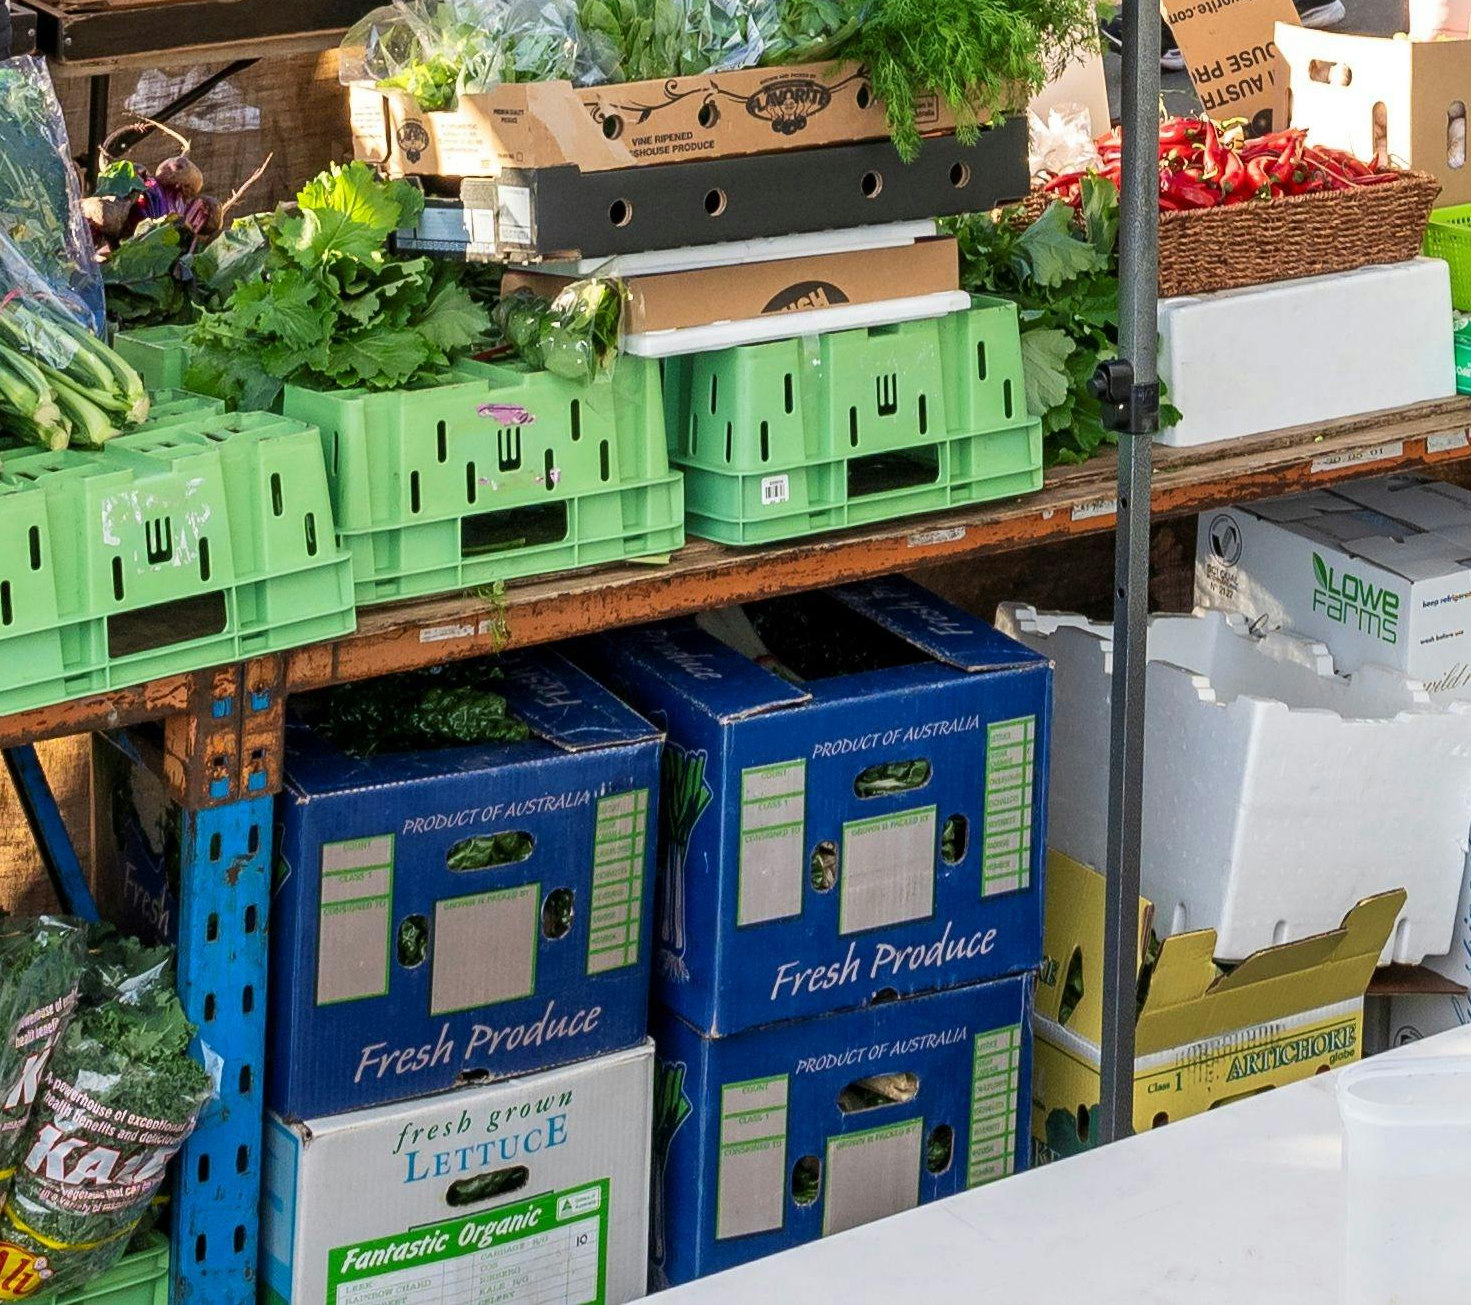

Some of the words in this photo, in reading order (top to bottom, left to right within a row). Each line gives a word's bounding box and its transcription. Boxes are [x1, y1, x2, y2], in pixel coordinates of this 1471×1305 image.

[1200, 73, 1263, 111] AUSTR
[631, 136, 652, 147] VINE
[654, 131, 693, 144] RIPENED
[631, 147, 672, 158] SHOUSE
[673, 140, 715, 154] PRODUCE
[812, 733, 879, 759] PRODUCT
[882, 729, 902, 745] OF
[904, 715, 980, 741] AUSTRALIA
[402, 809, 479, 835] PRODUCT
[481, 805, 503, 822] OF
[504, 791, 591, 819] AUSTRALIA
[770, 941, 860, 1001] Fresh
[870, 921, 997, 978] Produce
[354, 1024, 454, 1083] Fresh
[464, 1000, 602, 1060] Produce
[795, 1049, 863, 1074] PRODUCT
[867, 1045, 887, 1061] OF
[890, 1026, 968, 1056] AUSTRALIA
[1226, 1023, 1357, 1082] ARTICHOKE
[1330, 1049, 1355, 1065] globe
[45, 1072, 54, 1084] A
[54, 1079, 112, 1119] powerhouse
[114, 1109, 127, 1121] of
[128, 1113, 186, 1133] exceptional
[1148, 1082, 1170, 1093] Class
[43, 1093, 70, 1119] health
[72, 1107, 115, 1136] benefits
[118, 1125, 137, 1142] and
[392, 1110, 472, 1155] fresh
[489, 1089, 575, 1132] grown
[403, 1113, 569, 1183] LETTUCE
[341, 1227, 447, 1274] Fantastic
[458, 1206, 544, 1249] Organic
